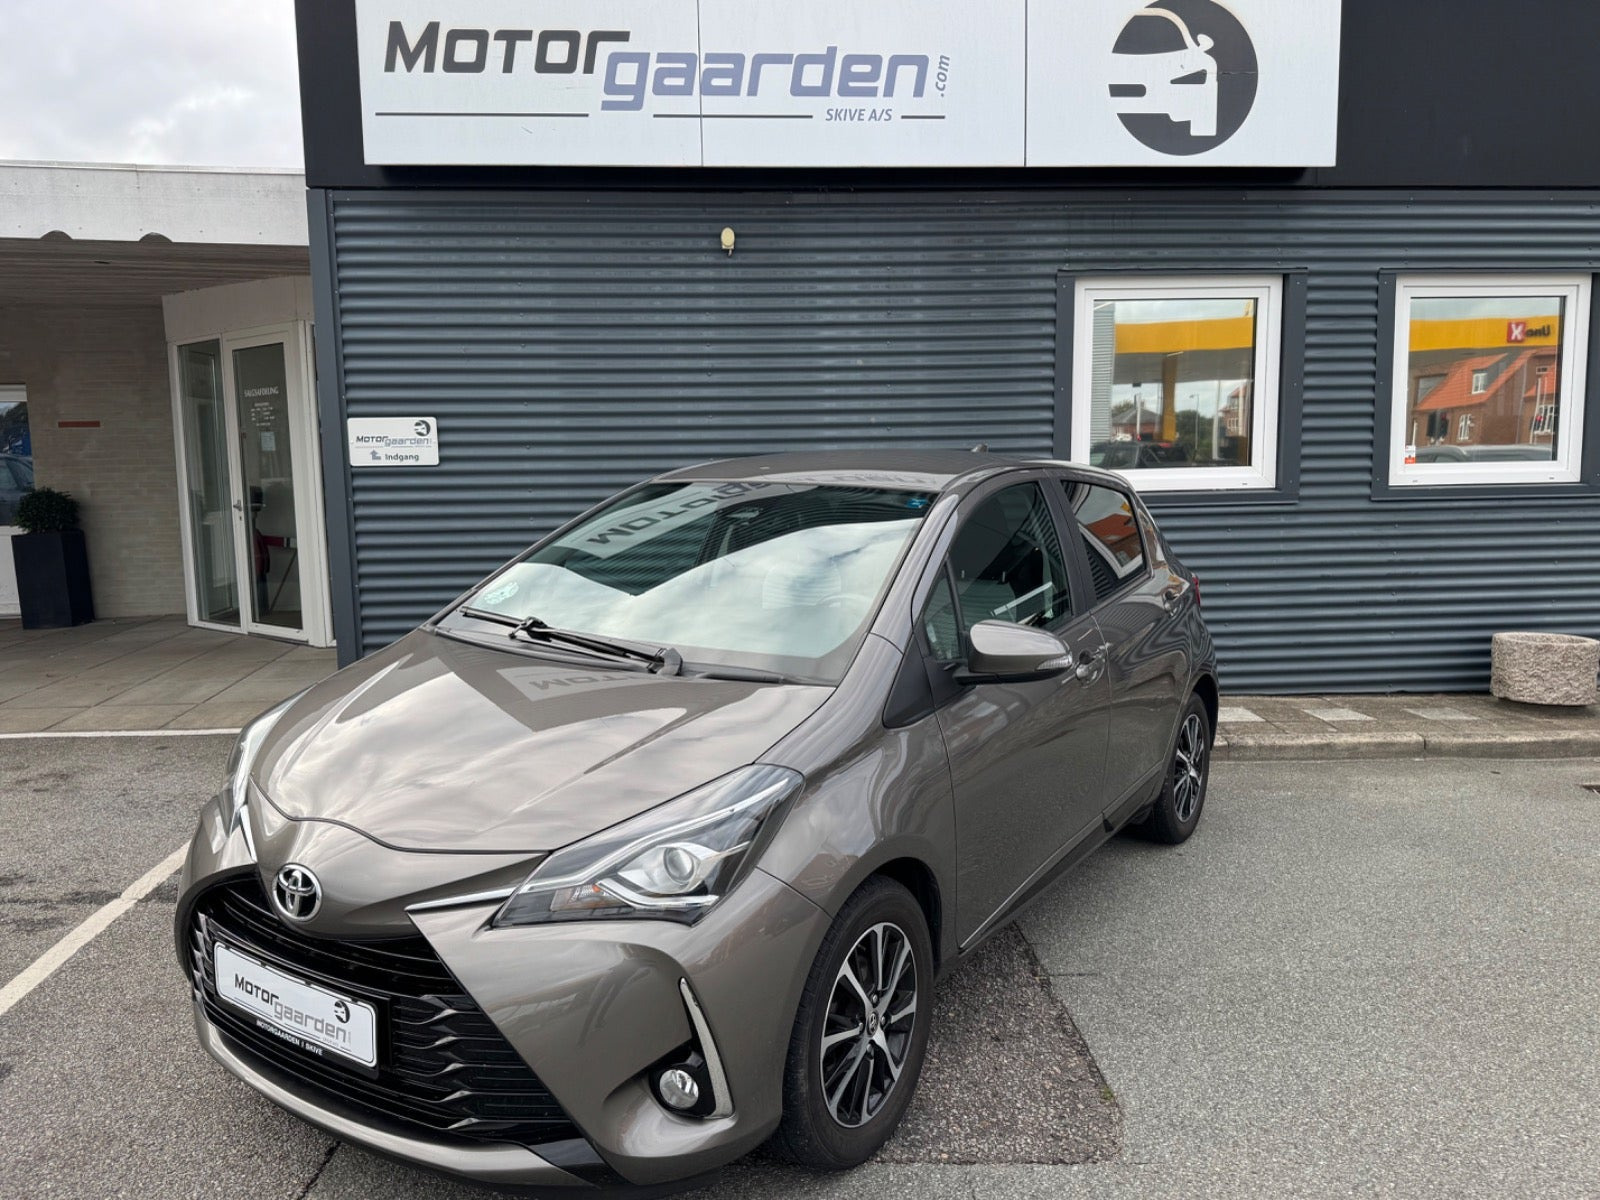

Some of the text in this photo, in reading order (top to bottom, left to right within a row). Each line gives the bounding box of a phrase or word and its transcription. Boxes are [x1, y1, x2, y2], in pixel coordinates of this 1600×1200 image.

[825, 108, 893, 122] SKIVE A/S
[385, 453, 419, 461] Indgang
[305, 1043, 323, 1056] SKIVE
